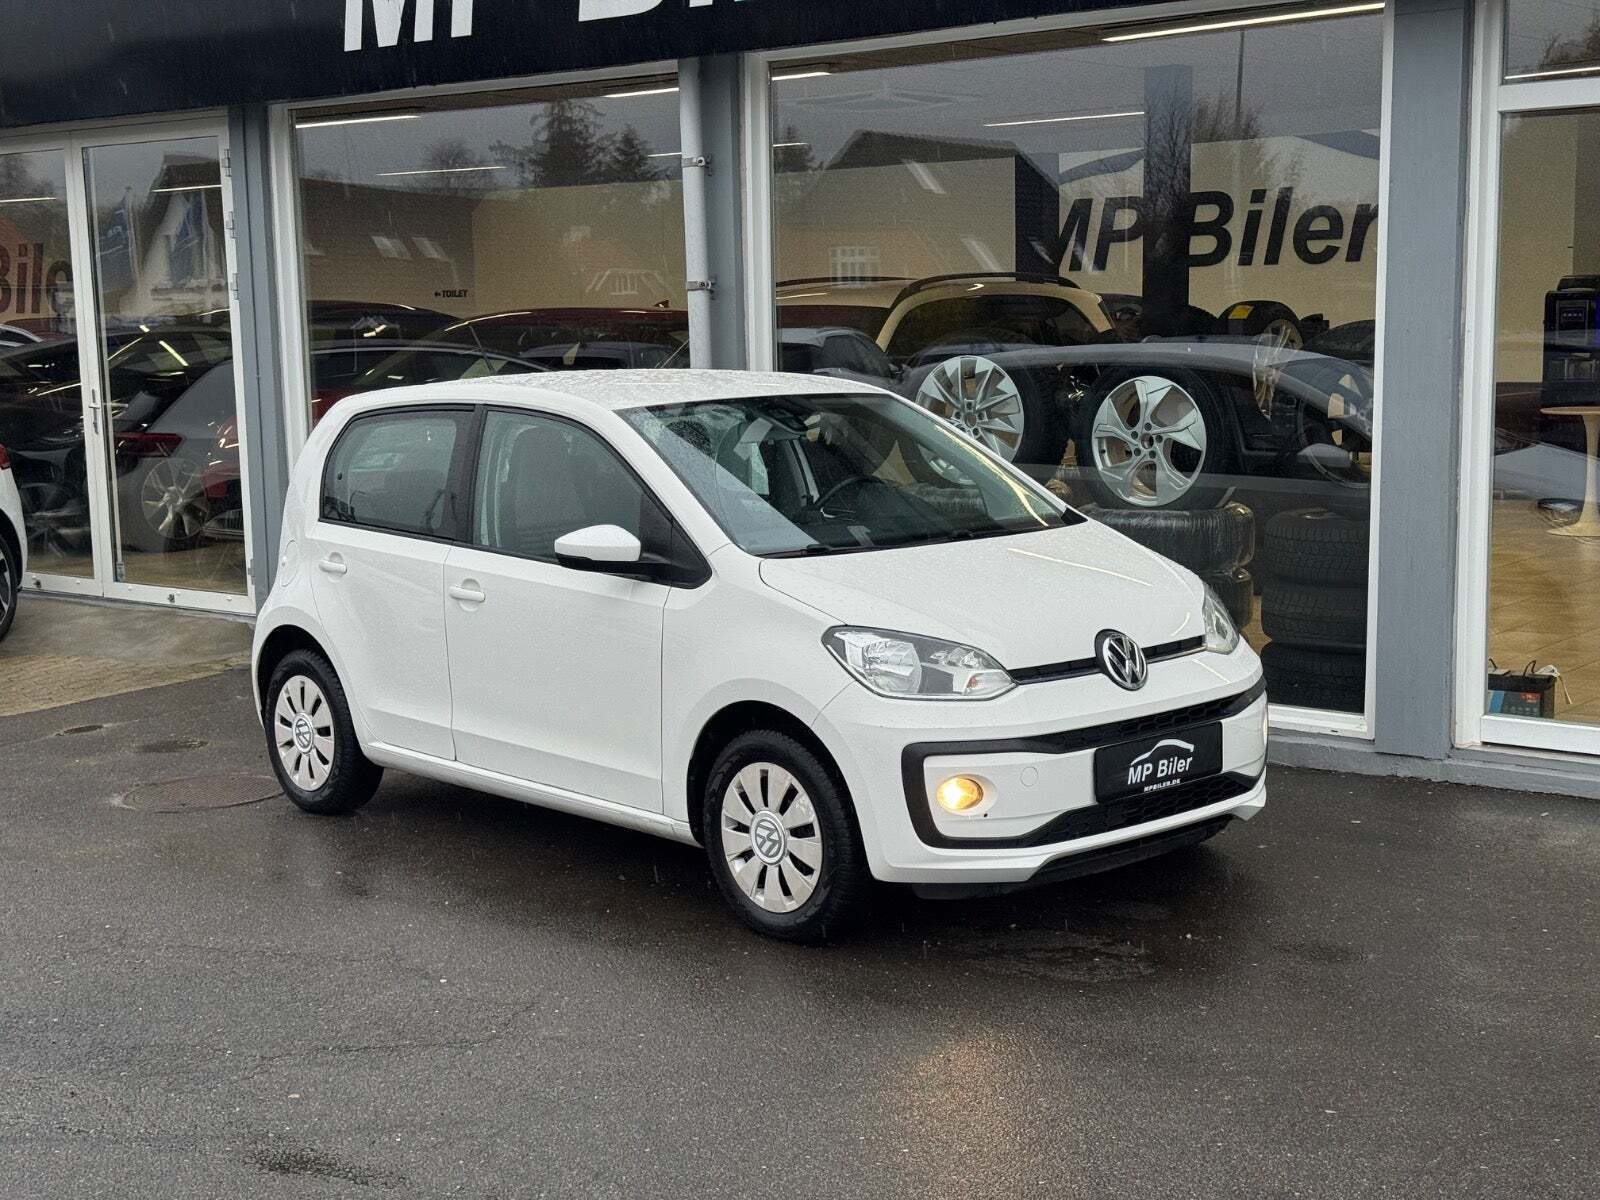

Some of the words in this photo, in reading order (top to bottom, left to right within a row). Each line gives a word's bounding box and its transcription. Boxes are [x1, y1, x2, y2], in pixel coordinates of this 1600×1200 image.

[1187, 187, 1378, 267] Biler
[442, 289, 468, 298] TOILET
[1127, 763, 1153, 785] MP
[1157, 756, 1193, 778] Biler
